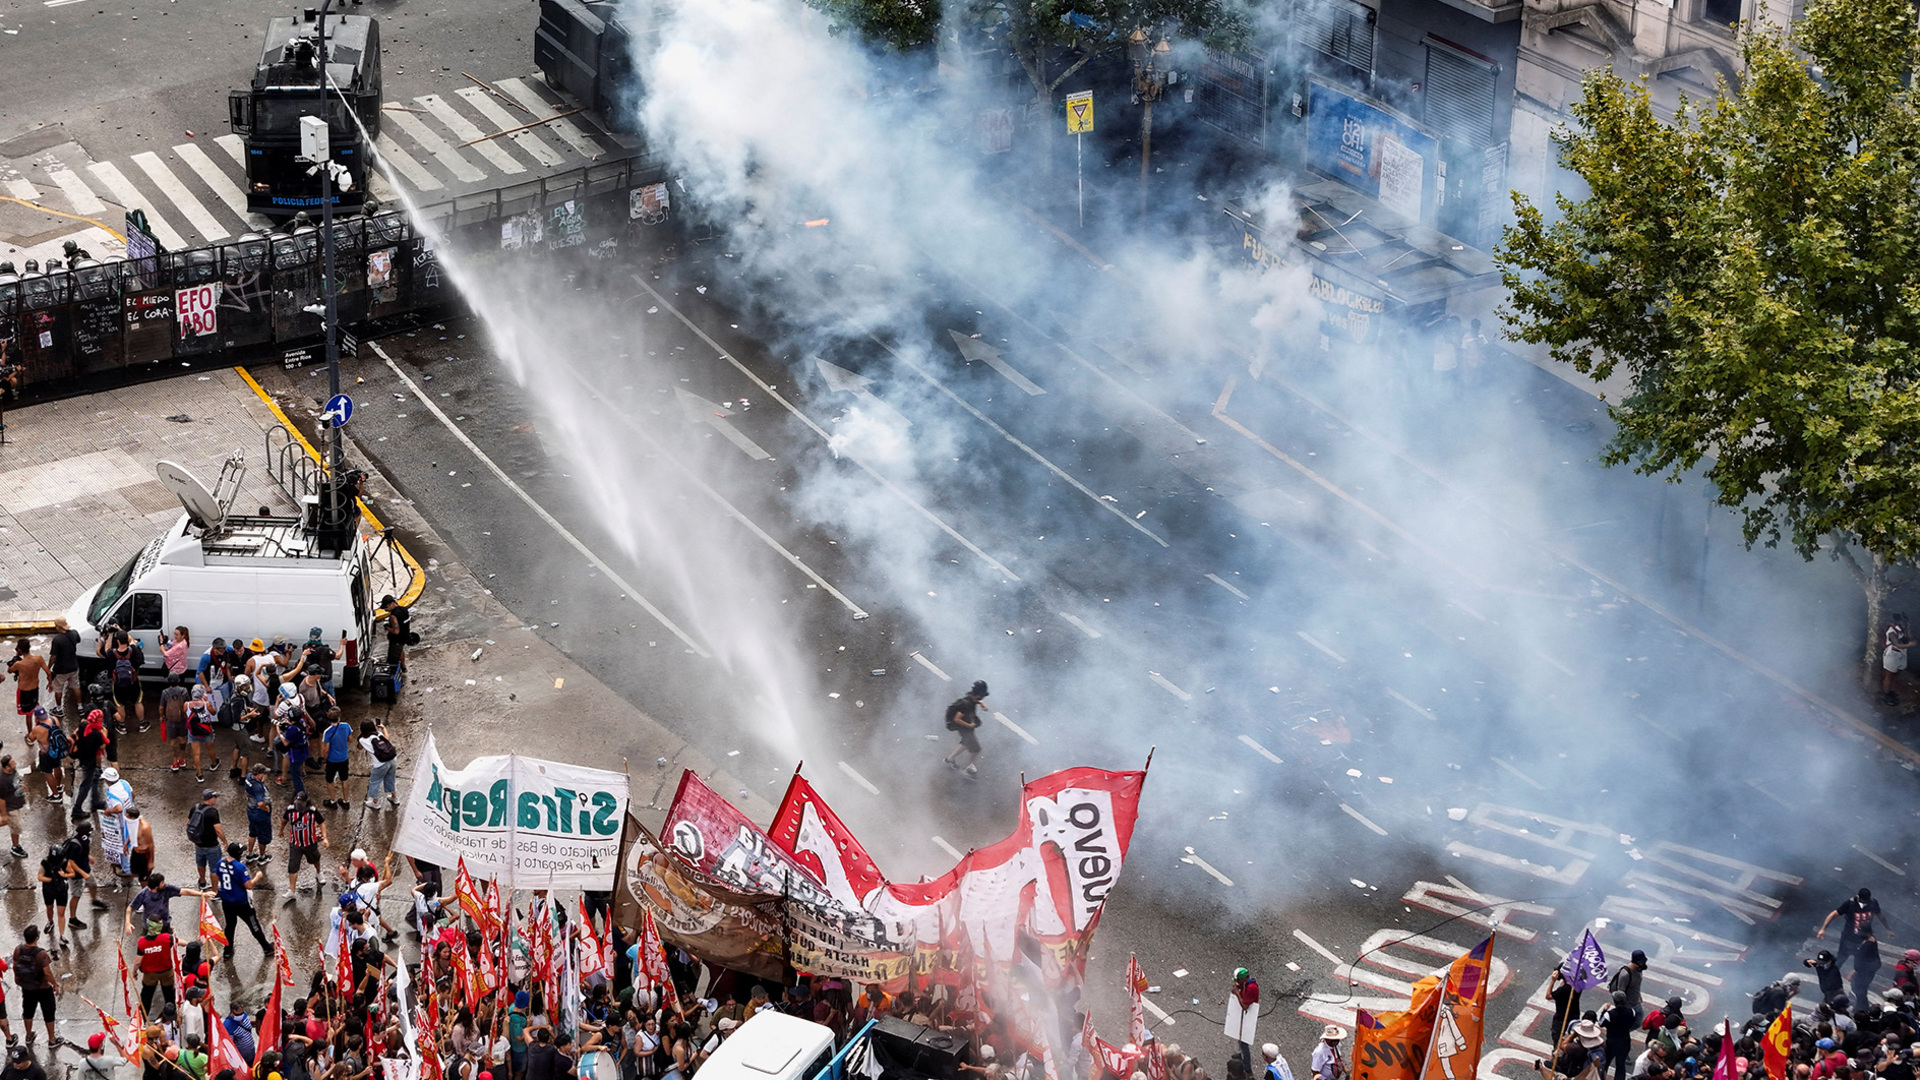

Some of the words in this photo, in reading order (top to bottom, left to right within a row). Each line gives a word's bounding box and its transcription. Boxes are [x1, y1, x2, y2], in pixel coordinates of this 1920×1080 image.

[272, 196, 305, 206] POLICIA
[305, 195, 341, 206] FEDEAL
[558, 215, 583, 227] AGUA
[126, 297, 139, 307] EL
[142, 295, 170, 305] MIEDO
[127, 311, 139, 321] EL
[222, 873, 232, 891] 8
[144, 945, 163, 955] mas
